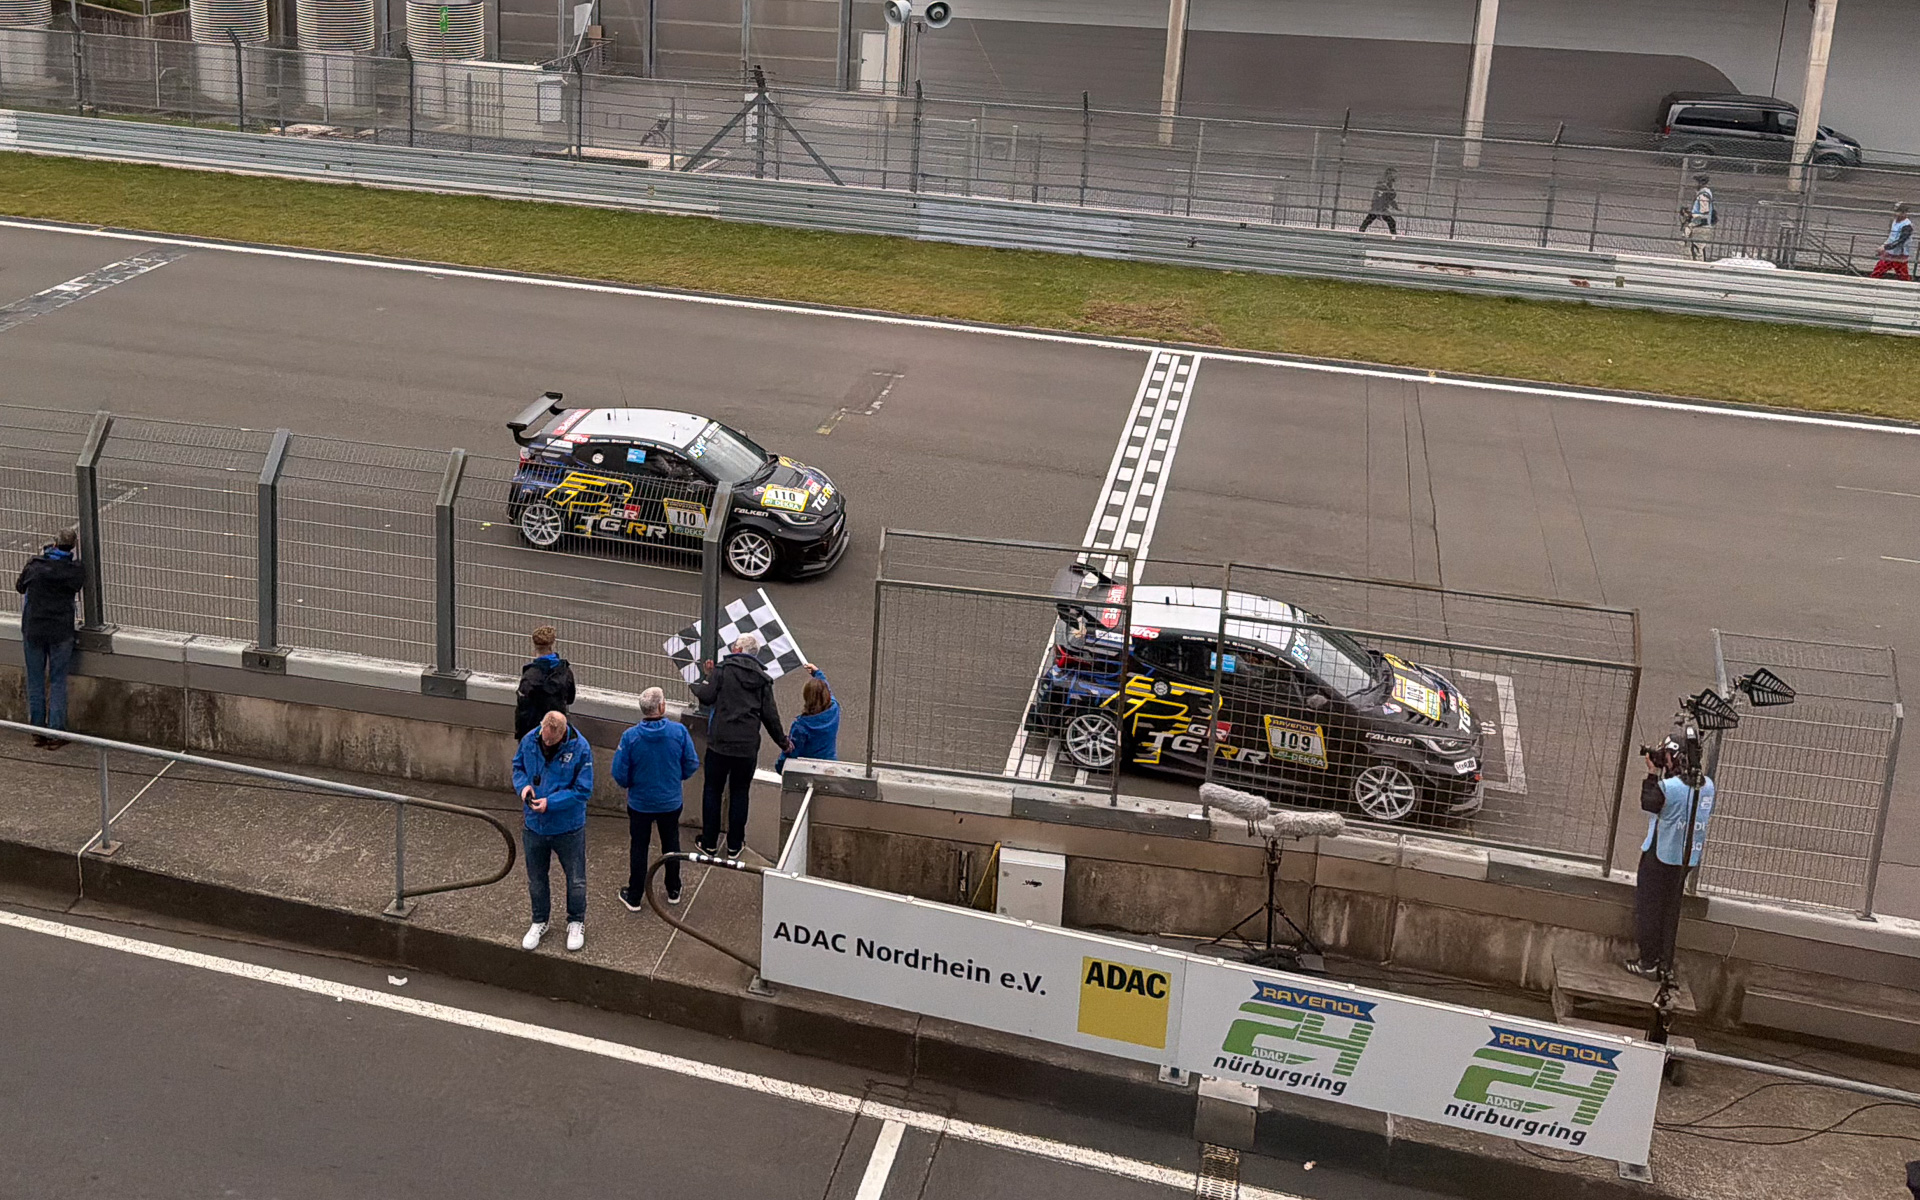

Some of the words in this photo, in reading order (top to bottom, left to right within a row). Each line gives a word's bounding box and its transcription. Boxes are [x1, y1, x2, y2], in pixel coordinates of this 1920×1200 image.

[774, 490, 796, 502] 110
[610, 506, 640, 520] GR
[676, 510, 697, 526] 110
[733, 507, 769, 518] FALKEN
[1271, 719, 1316, 732] RAVENOL
[1279, 731, 1312, 751] 109
[1365, 732, 1412, 745] FALKEN
[1291, 754, 1325, 767] DEKRA
[773, 921, 847, 954] ADAC
[856, 938, 991, 984] Nordrhein
[1000, 973, 1047, 996] e.V.
[1085, 961, 1167, 999] ADAC
[1262, 987, 1366, 1016] RAVENOL
[1251, 1047, 1285, 1062] ADAC
[1499, 1033, 1609, 1064] RAVENOL
[1213, 1056, 1348, 1096] nürburgring
[1485, 1095, 1520, 1110] ADAC
[1443, 1103, 1588, 1146] nürburgring
